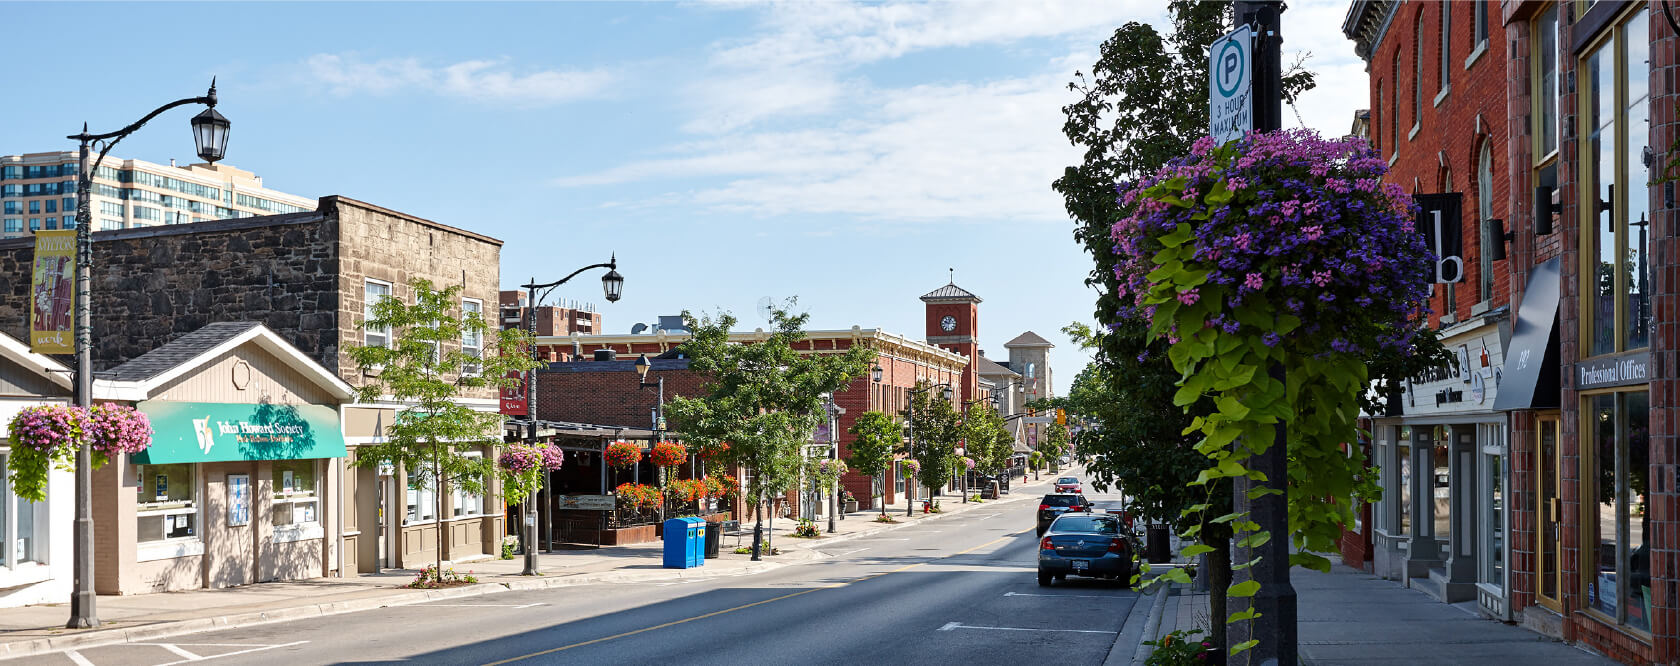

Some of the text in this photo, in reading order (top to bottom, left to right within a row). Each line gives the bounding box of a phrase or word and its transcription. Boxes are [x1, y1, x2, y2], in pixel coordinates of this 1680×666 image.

[1225, 52, 1238, 84] P
[1217, 94, 1245, 119] 3 HOUR
[1214, 109, 1248, 136] MAXIMUM
[37, 332, 68, 347] work
[1581, 359, 1646, 385] Professional Offices
[216, 421, 303, 438] John Howard Society
